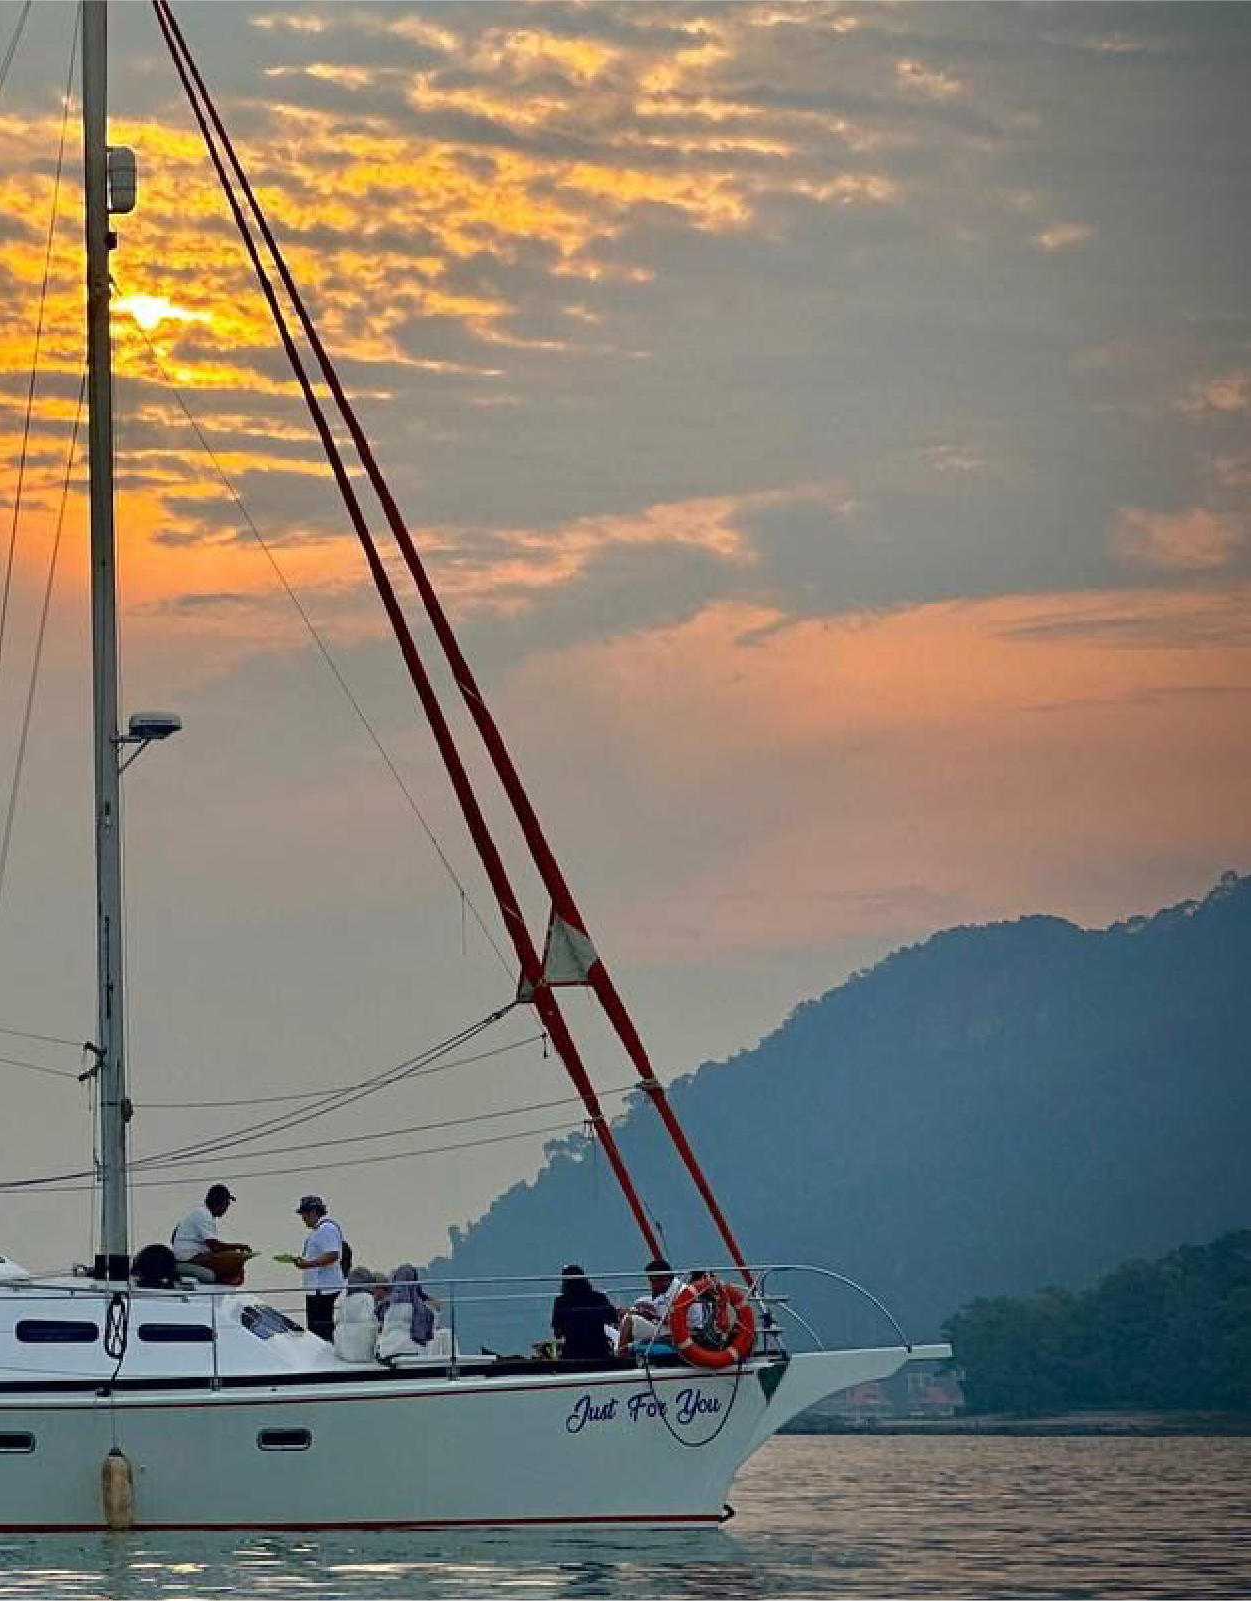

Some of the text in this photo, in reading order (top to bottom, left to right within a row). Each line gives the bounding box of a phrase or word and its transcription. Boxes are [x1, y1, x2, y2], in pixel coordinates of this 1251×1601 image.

[566, 1388, 722, 1433] Just For You
